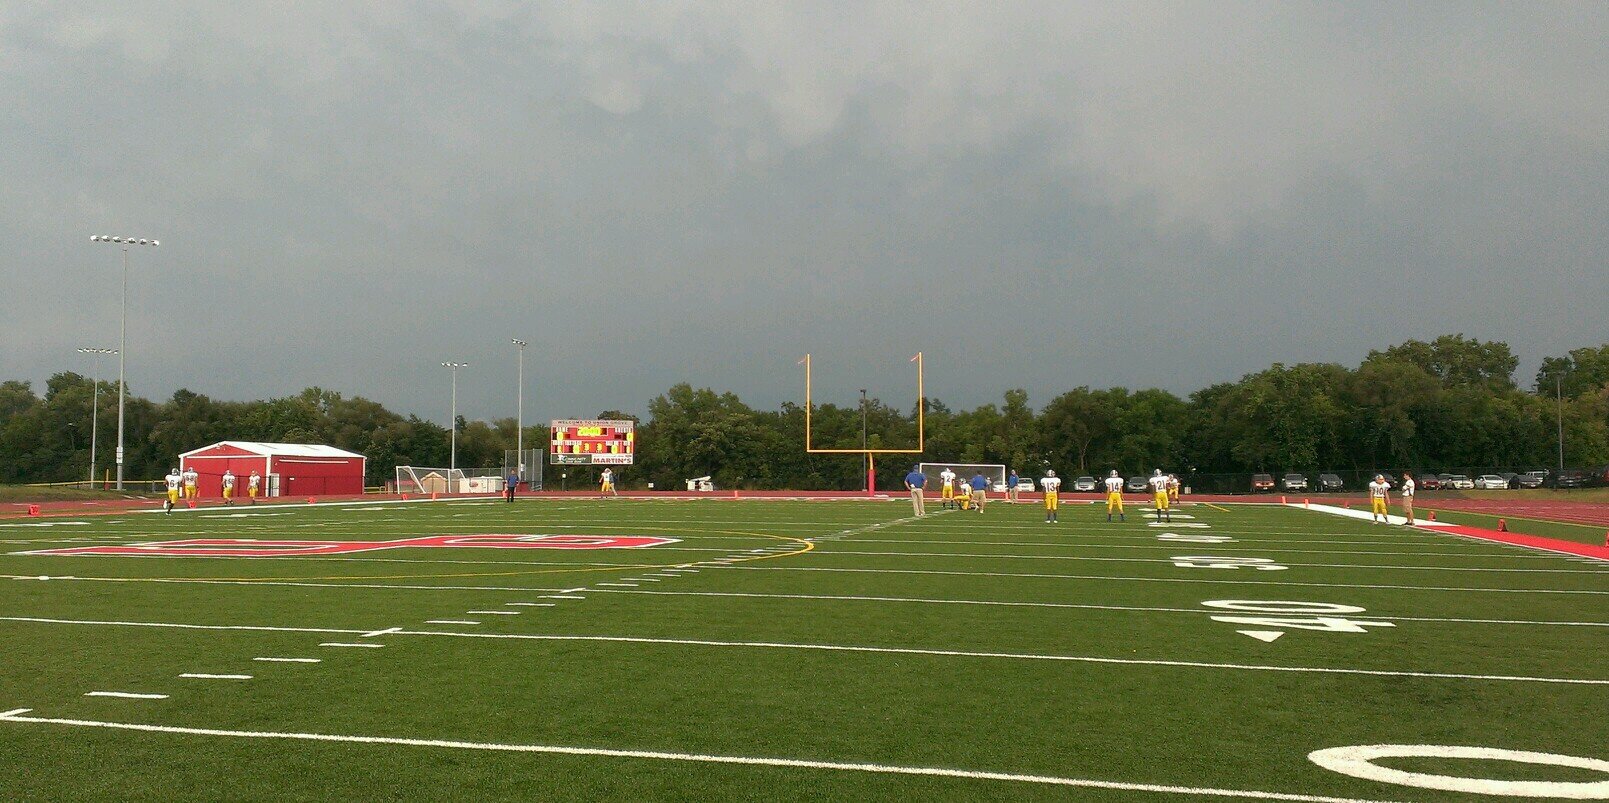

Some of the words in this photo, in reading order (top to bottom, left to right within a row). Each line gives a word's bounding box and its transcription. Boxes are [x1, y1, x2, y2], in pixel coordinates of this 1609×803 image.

[170, 479, 175, 488] 6
[946, 475, 951, 483] 2
[1046, 481, 1056, 492] 13
[1111, 481, 1120, 492] 14
[1156, 480, 1166, 491] 21
[1374, 487, 1384, 496] 10
[1200, 599, 1397, 632] 40
